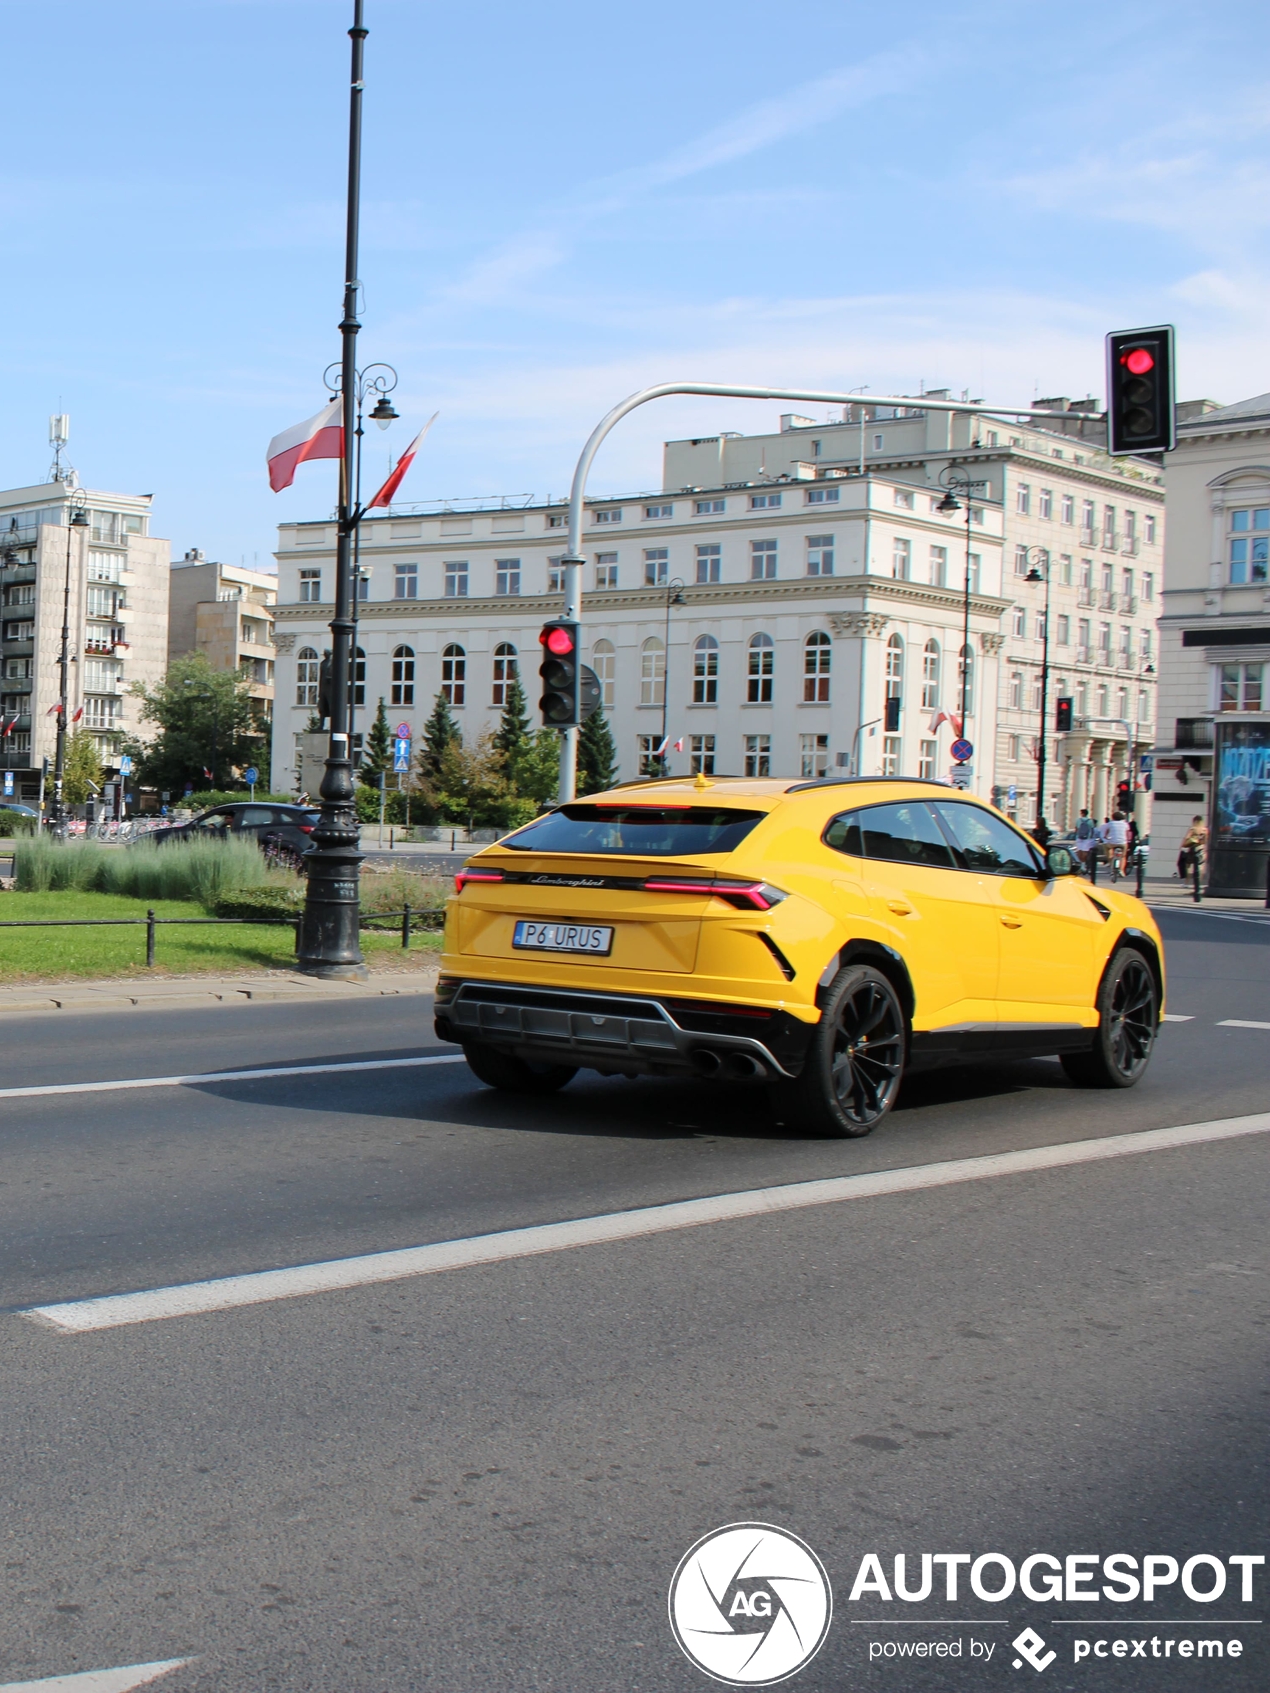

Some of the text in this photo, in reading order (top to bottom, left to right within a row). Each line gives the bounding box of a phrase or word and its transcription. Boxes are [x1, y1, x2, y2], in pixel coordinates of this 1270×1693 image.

[531, 875, 605, 887] Lamborghini
[525, 924, 602, 949] P6 URUS
